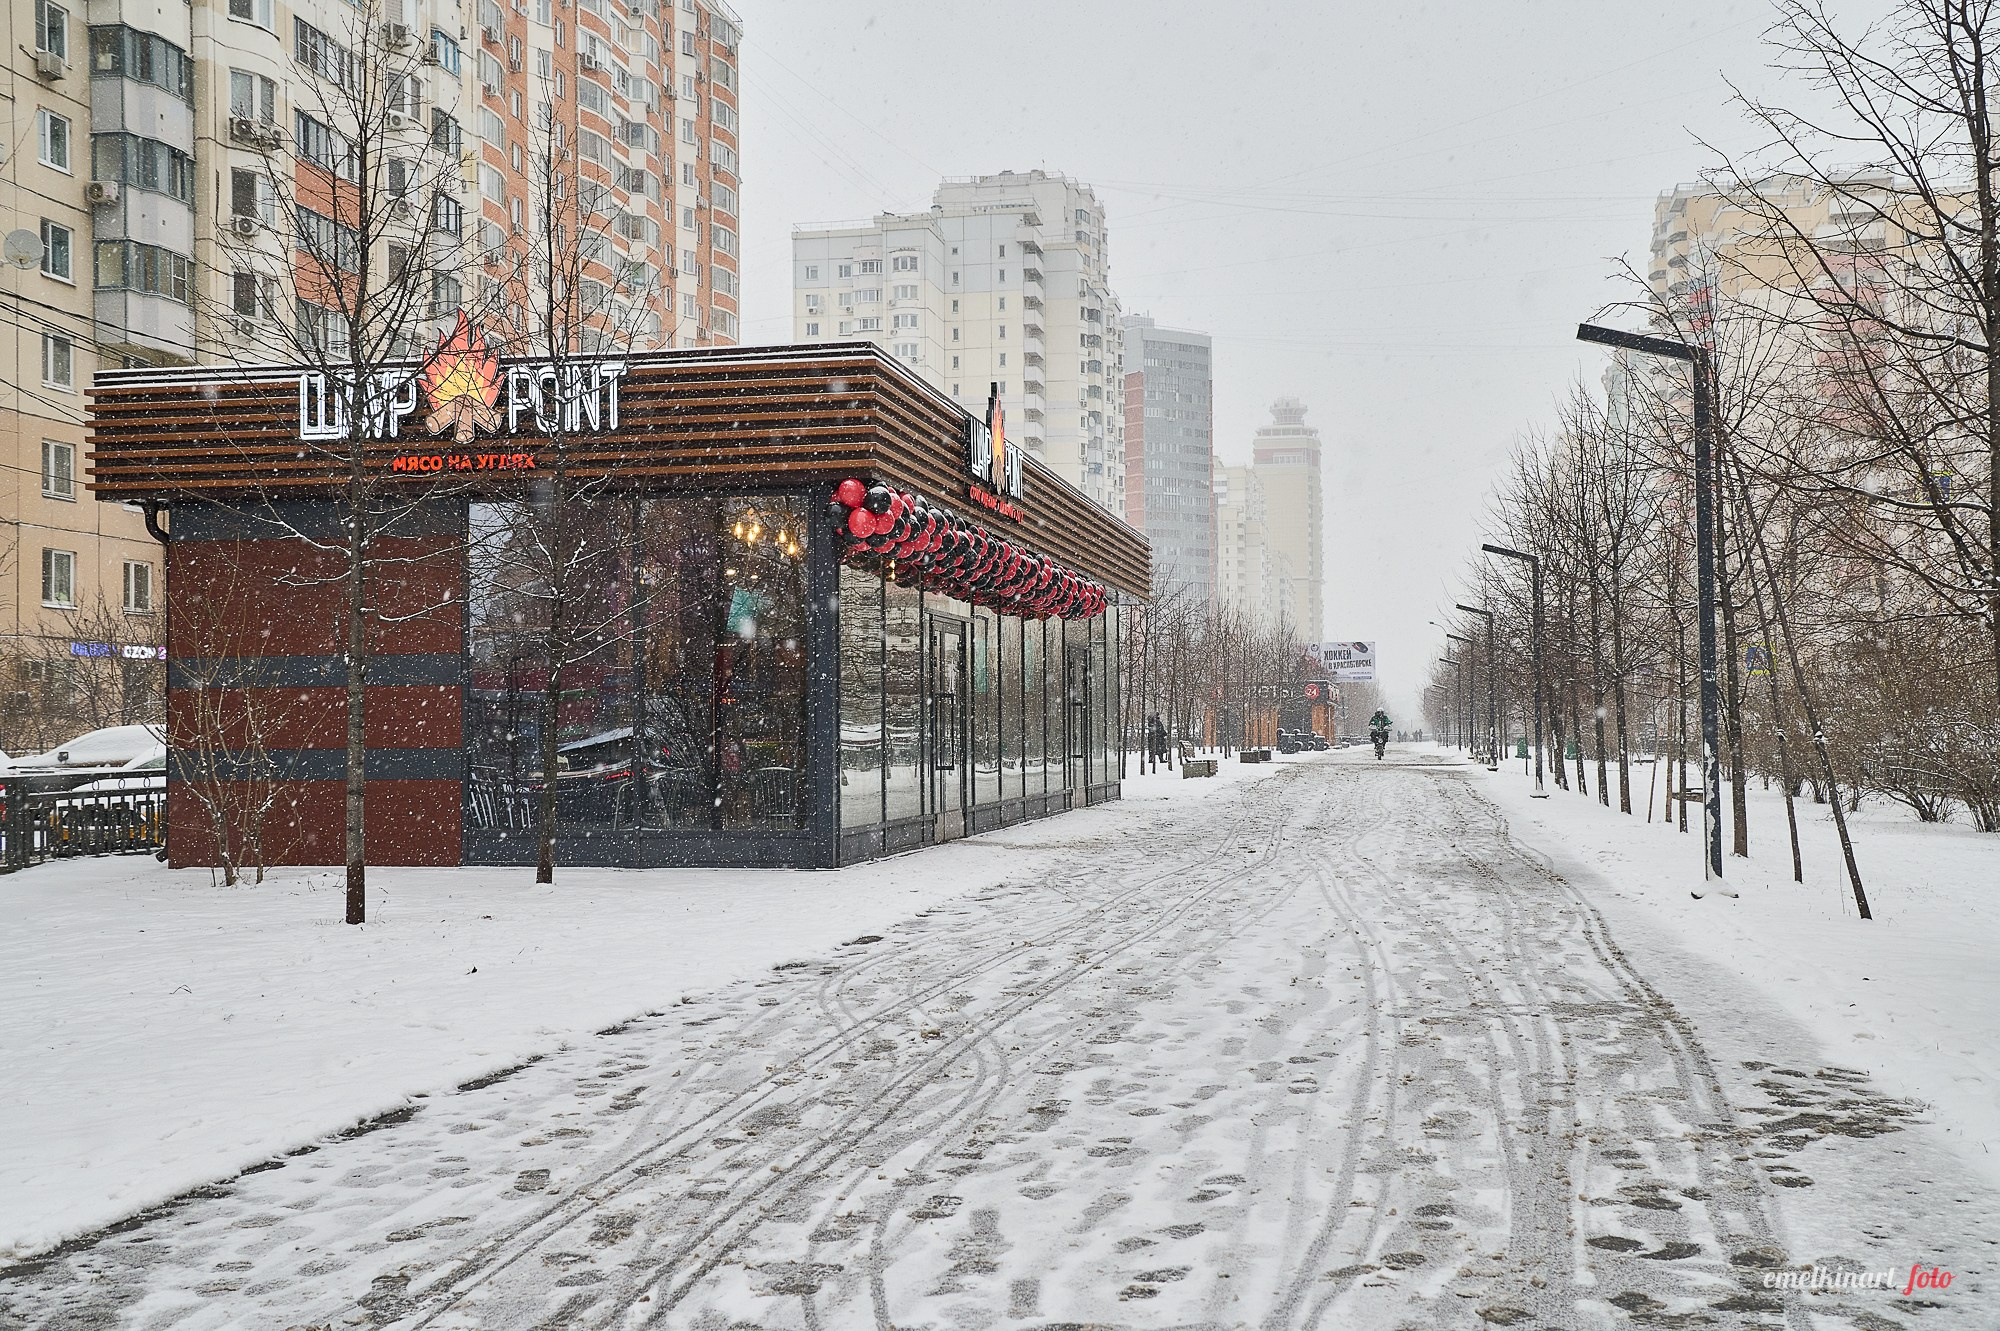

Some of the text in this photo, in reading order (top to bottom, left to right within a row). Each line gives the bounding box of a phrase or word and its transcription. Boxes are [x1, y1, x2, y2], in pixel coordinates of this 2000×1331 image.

[508, 363, 628, 433] POINT
[392, 453, 536, 472] МЯСО НА УГЛЯХ
[123, 645, 156, 659] OZON
[1323, 647, 1352, 661] ХОККЕЙ
[1307, 688, 1317, 696] 24
